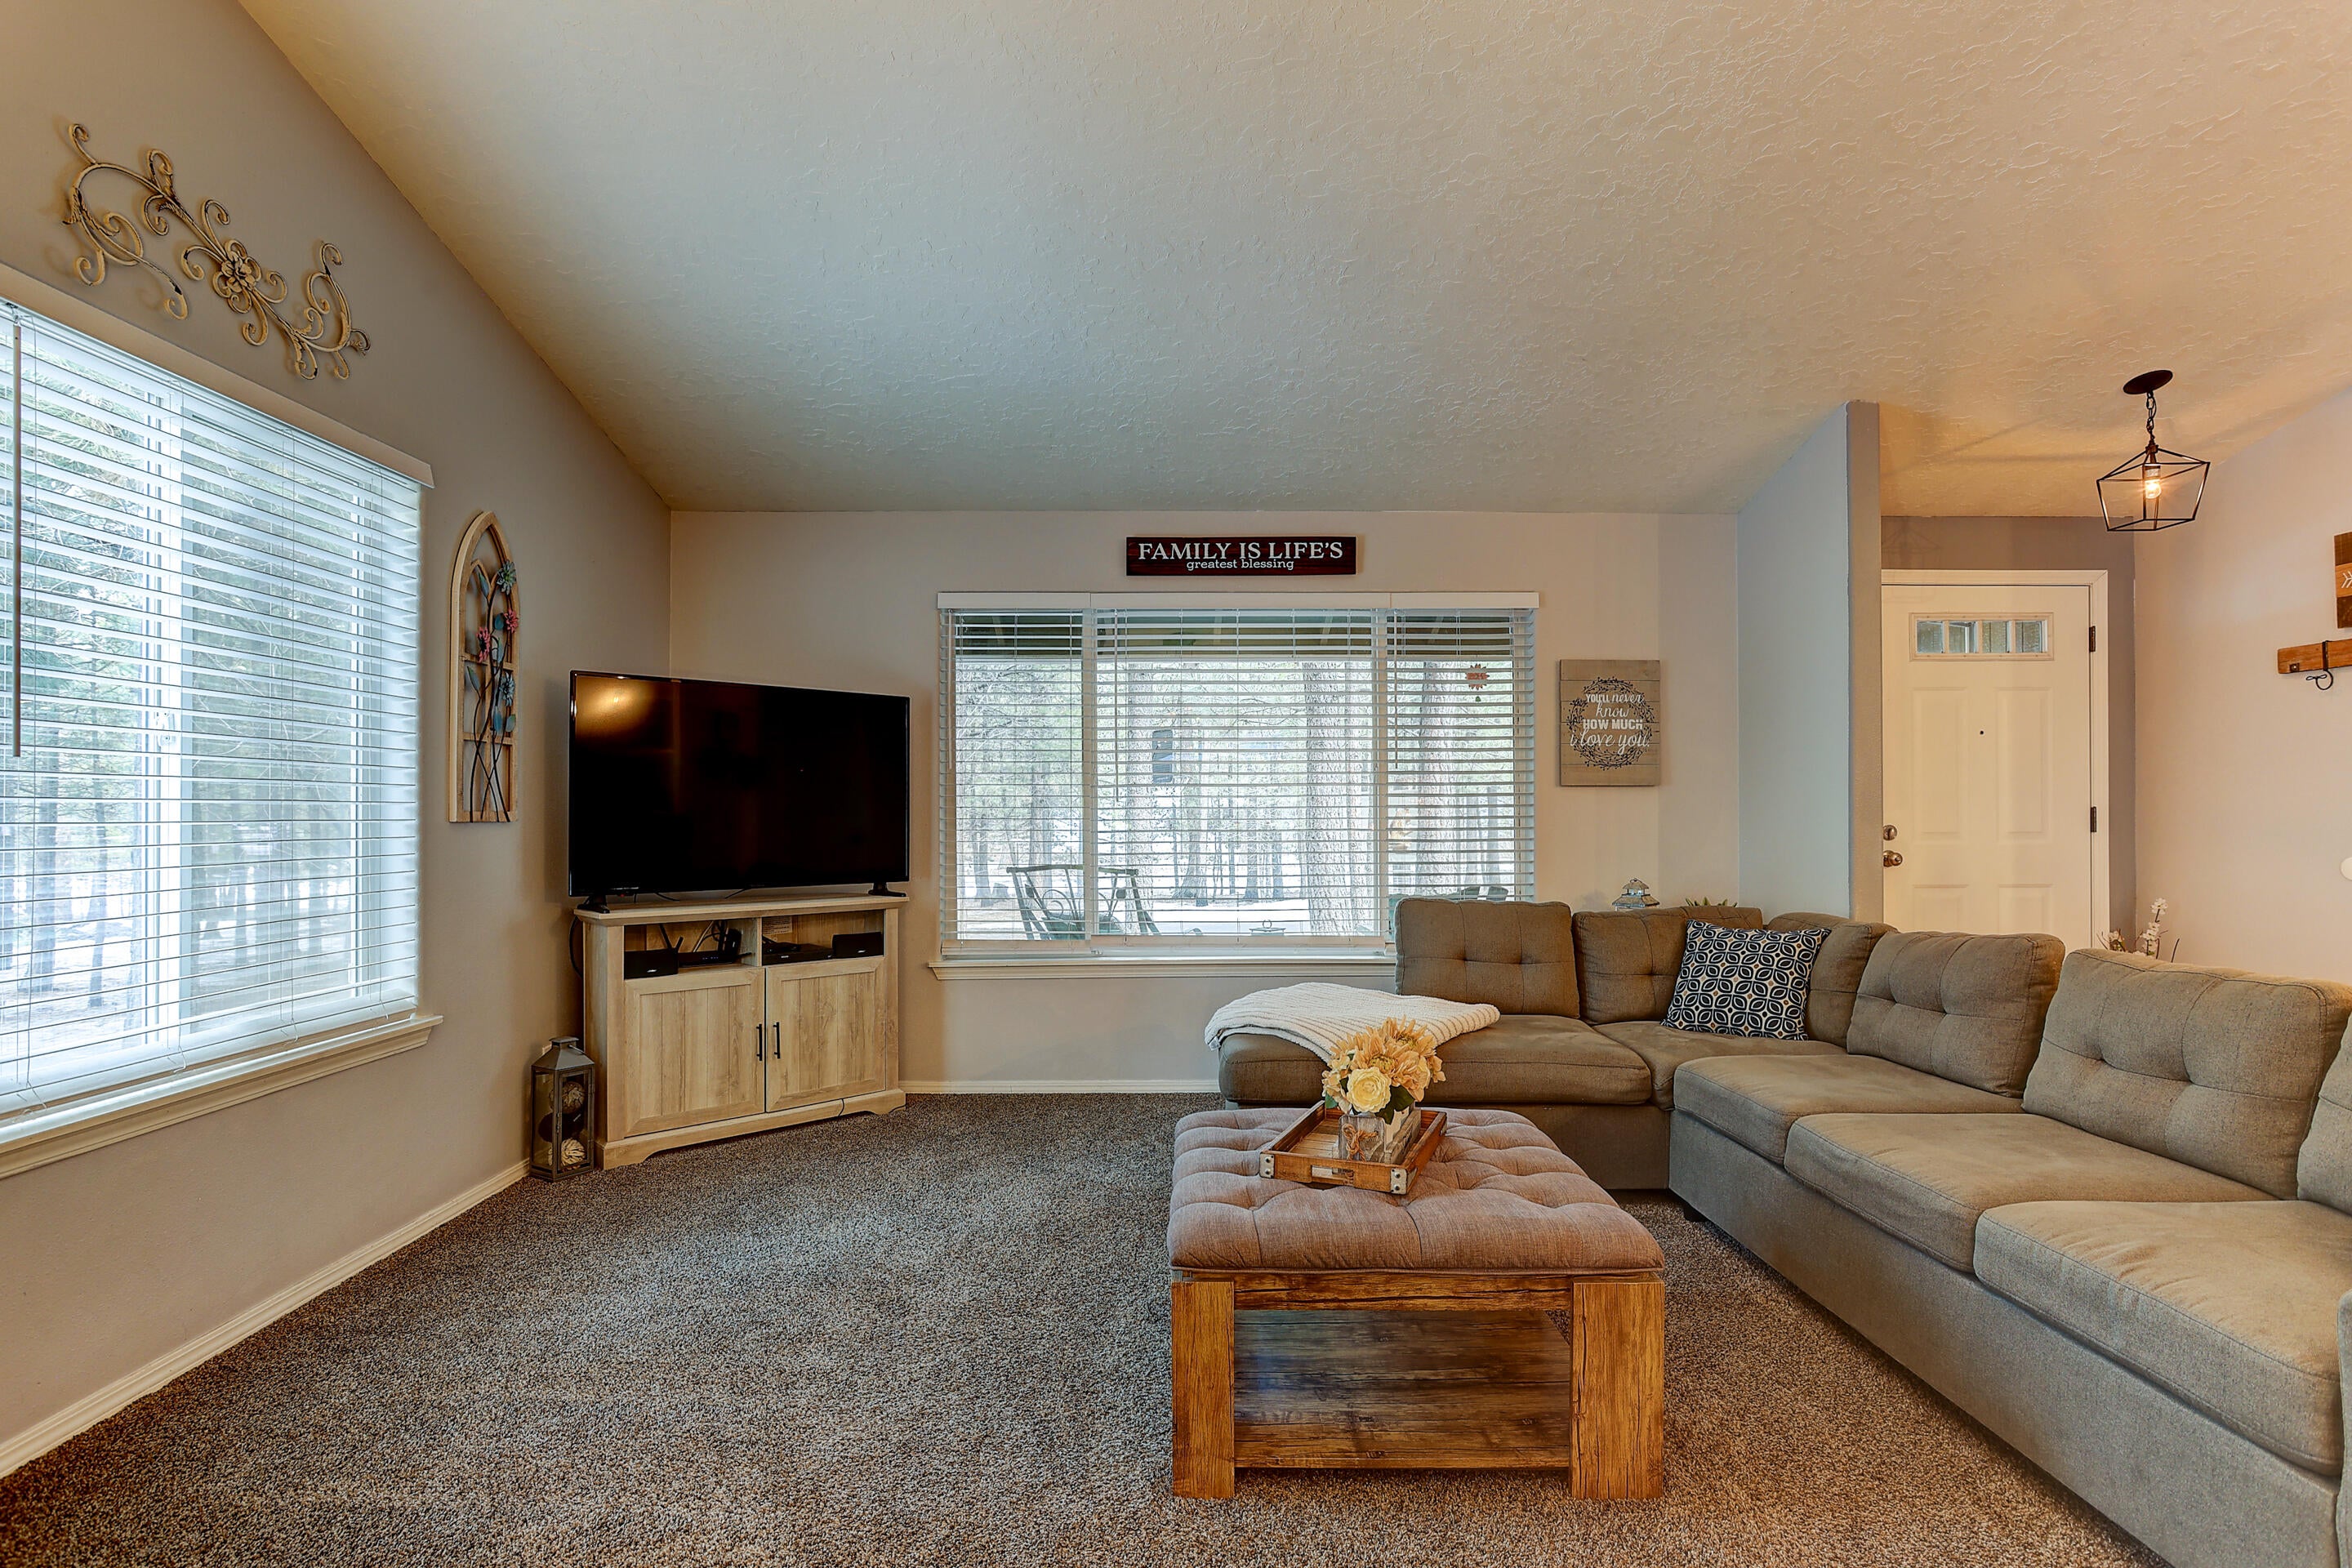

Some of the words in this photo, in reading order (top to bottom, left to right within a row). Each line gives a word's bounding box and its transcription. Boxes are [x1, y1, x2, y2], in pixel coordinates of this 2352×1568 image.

[1138, 542, 1232, 560] FAMILY
[1239, 542, 1261, 559] IS
[1268, 541, 1343, 559] LIFE'S
[1187, 559, 1237, 571] greatest
[1241, 559, 1294, 570] blessing
[1611, 693, 1644, 703] never
[1596, 702, 1628, 717] know
[1583, 719, 1609, 730] HOW
[1611, 719, 1643, 730] MUCH
[1570, 730, 1578, 746] i
[1579, 728, 1615, 746] love
